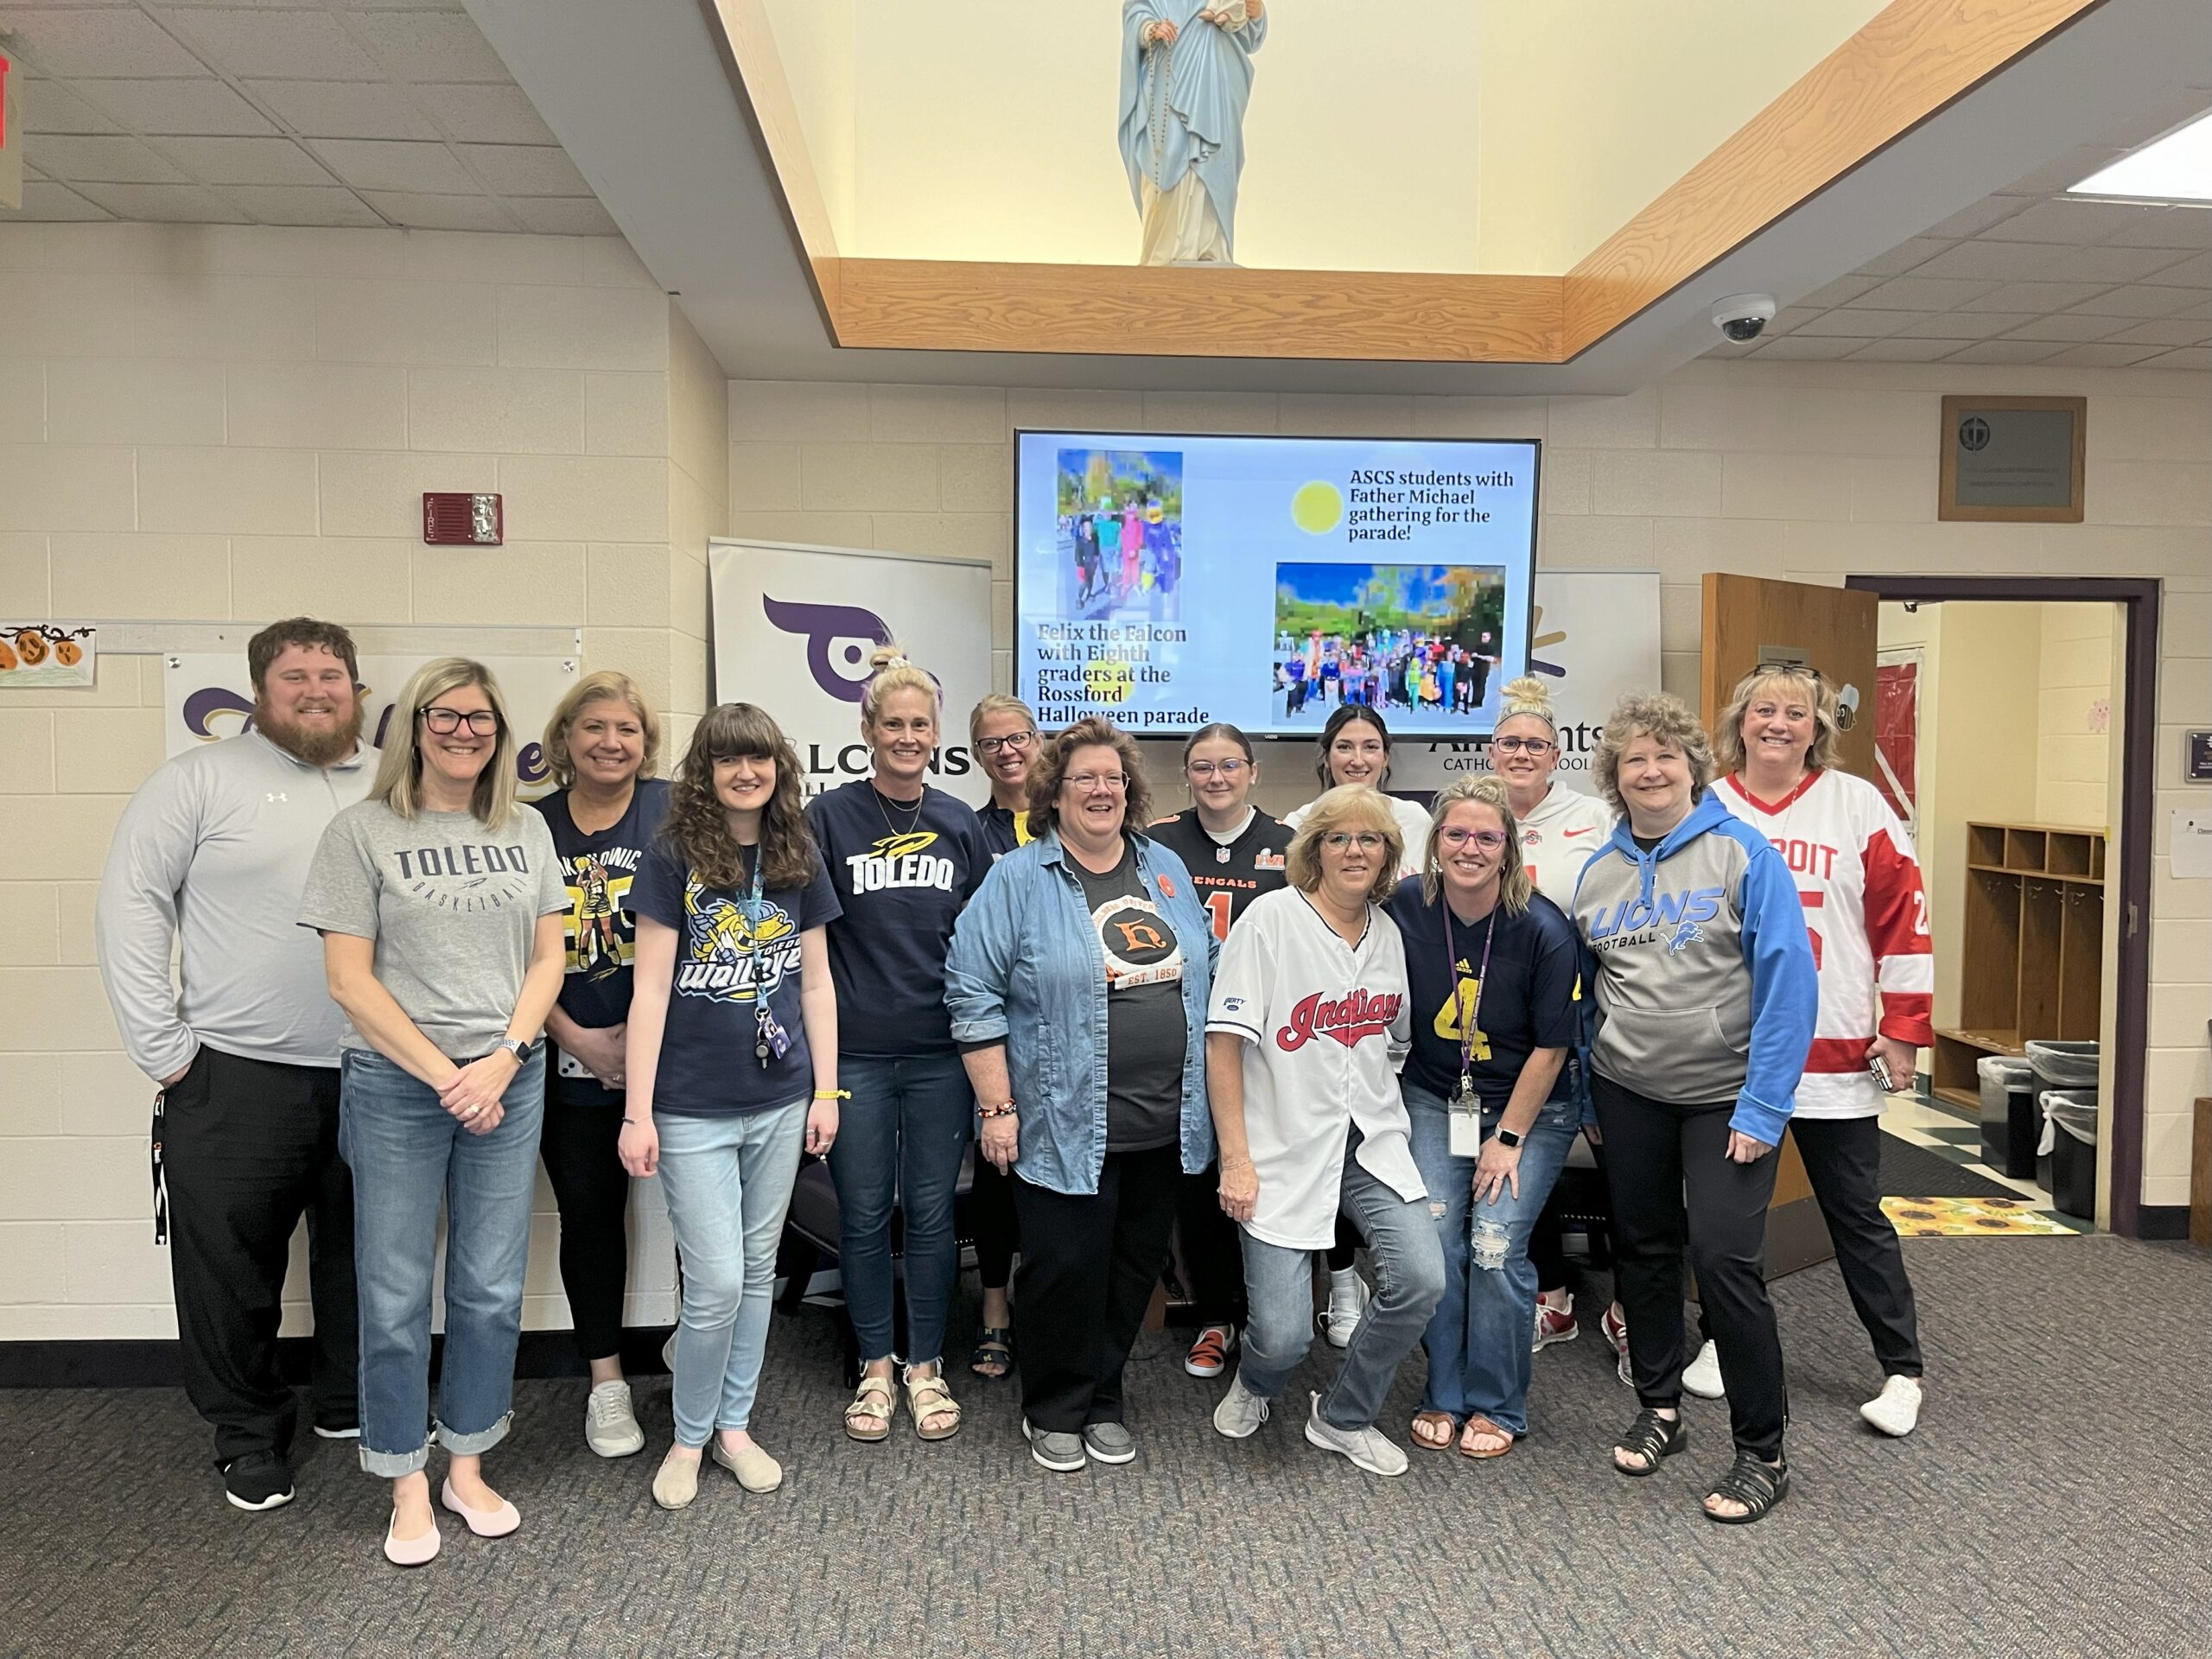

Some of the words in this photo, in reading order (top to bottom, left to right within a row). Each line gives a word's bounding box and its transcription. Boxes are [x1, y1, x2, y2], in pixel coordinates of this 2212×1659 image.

[1350, 470, 1395, 485] ASCS
[1399, 470, 1471, 486] students
[1475, 471, 1514, 486] with
[1350, 487, 1406, 503] Father
[1409, 488, 1475, 505] Michael
[1349, 506, 1432, 525] gathering
[1435, 507, 1460, 523] for
[1464, 508, 1491, 523] the
[1349, 525, 1411, 543] parade!
[1038, 622, 1085, 641] Felix
[1090, 623, 1121, 641] the
[1125, 624, 1187, 643] Falcon
[1038, 643, 1082, 661] with
[1087, 644, 1150, 665] Eighth
[1038, 664, 1112, 685] graders
[1116, 667, 1136, 683] at
[1141, 665, 1171, 683] the
[1038, 684, 1122, 702] Rossford
[1143, 707, 1210, 727] parade
[394, 845, 530, 879] TOLEDO
[846, 854, 955, 895] TOLEDO
[1191, 875, 1258, 889] ENGALS
[413, 878, 527, 912] BASKETBALL
[1591, 887, 1726, 941] LIONS
[1128, 972, 1150, 985] EST.
[1154, 968, 1178, 981] 1850
[1433, 977, 1493, 1061] 4
